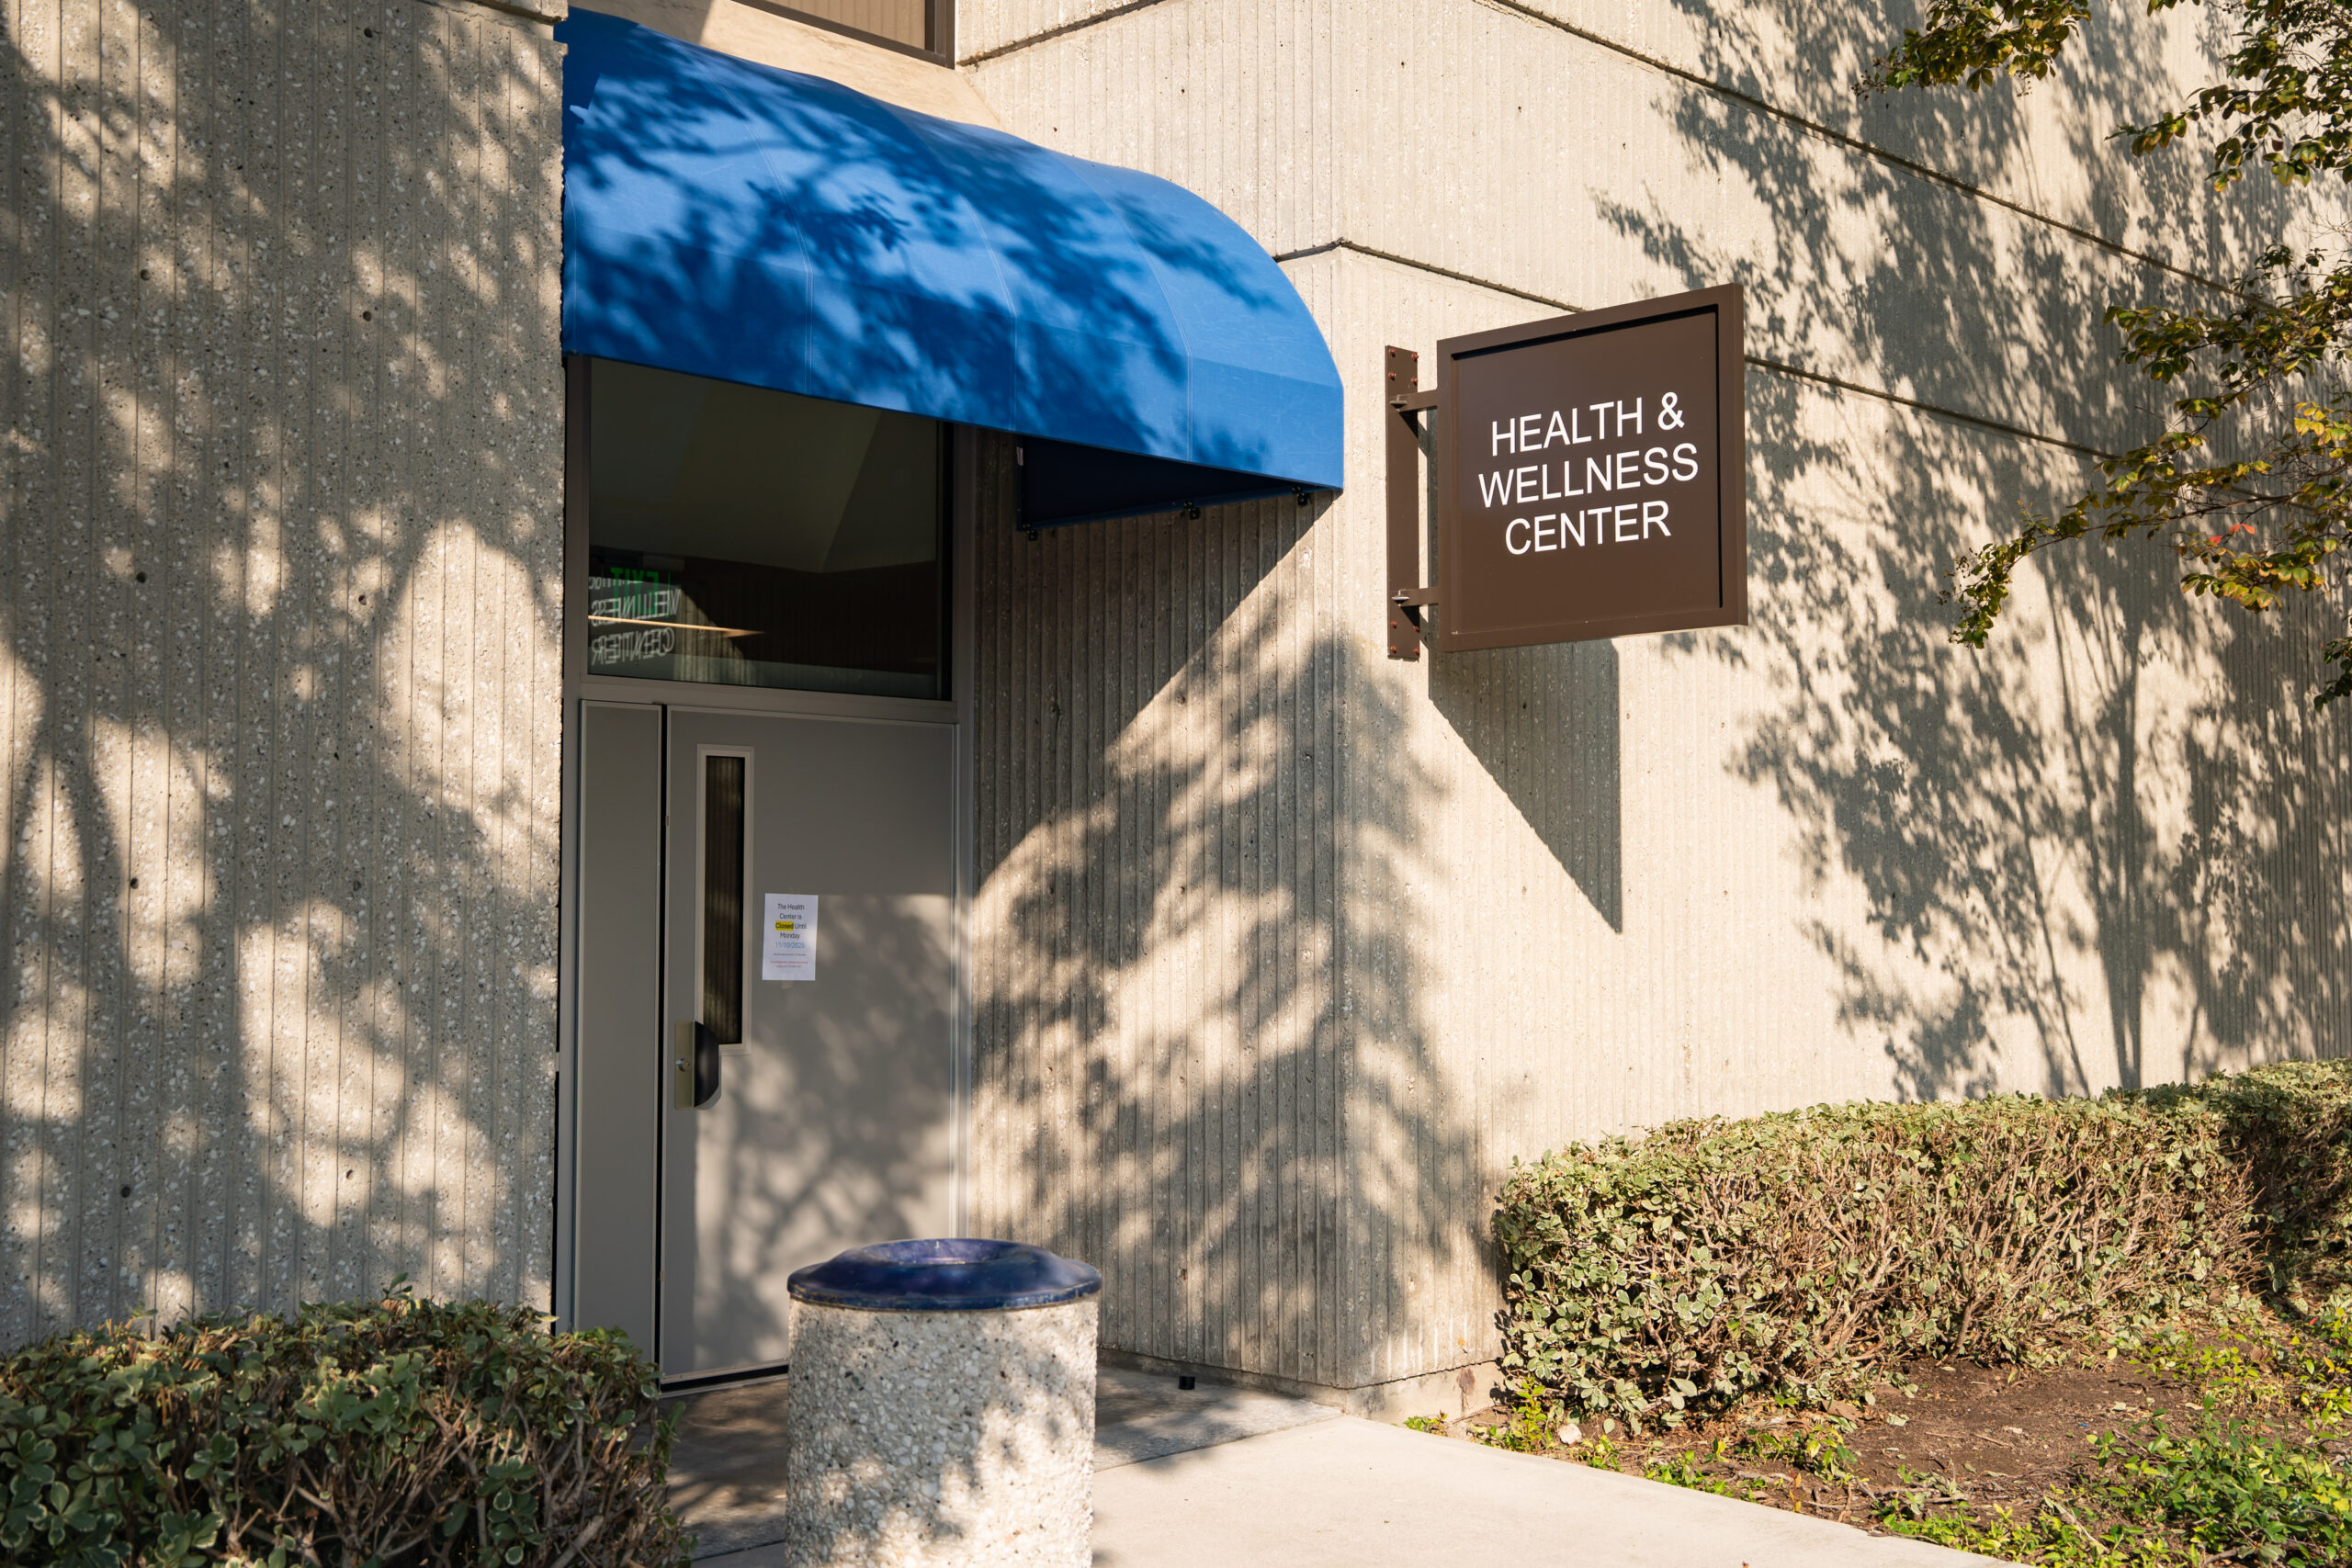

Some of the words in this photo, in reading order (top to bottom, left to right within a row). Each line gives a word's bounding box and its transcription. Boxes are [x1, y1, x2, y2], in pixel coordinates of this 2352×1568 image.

[1492, 397, 1643, 457] HEALTH
[1657, 391, 1685, 431] &
[1477, 442, 1699, 508] WELLNESS
[1505, 500, 1671, 555] CENTER
[779, 931, 800, 940] Monday
